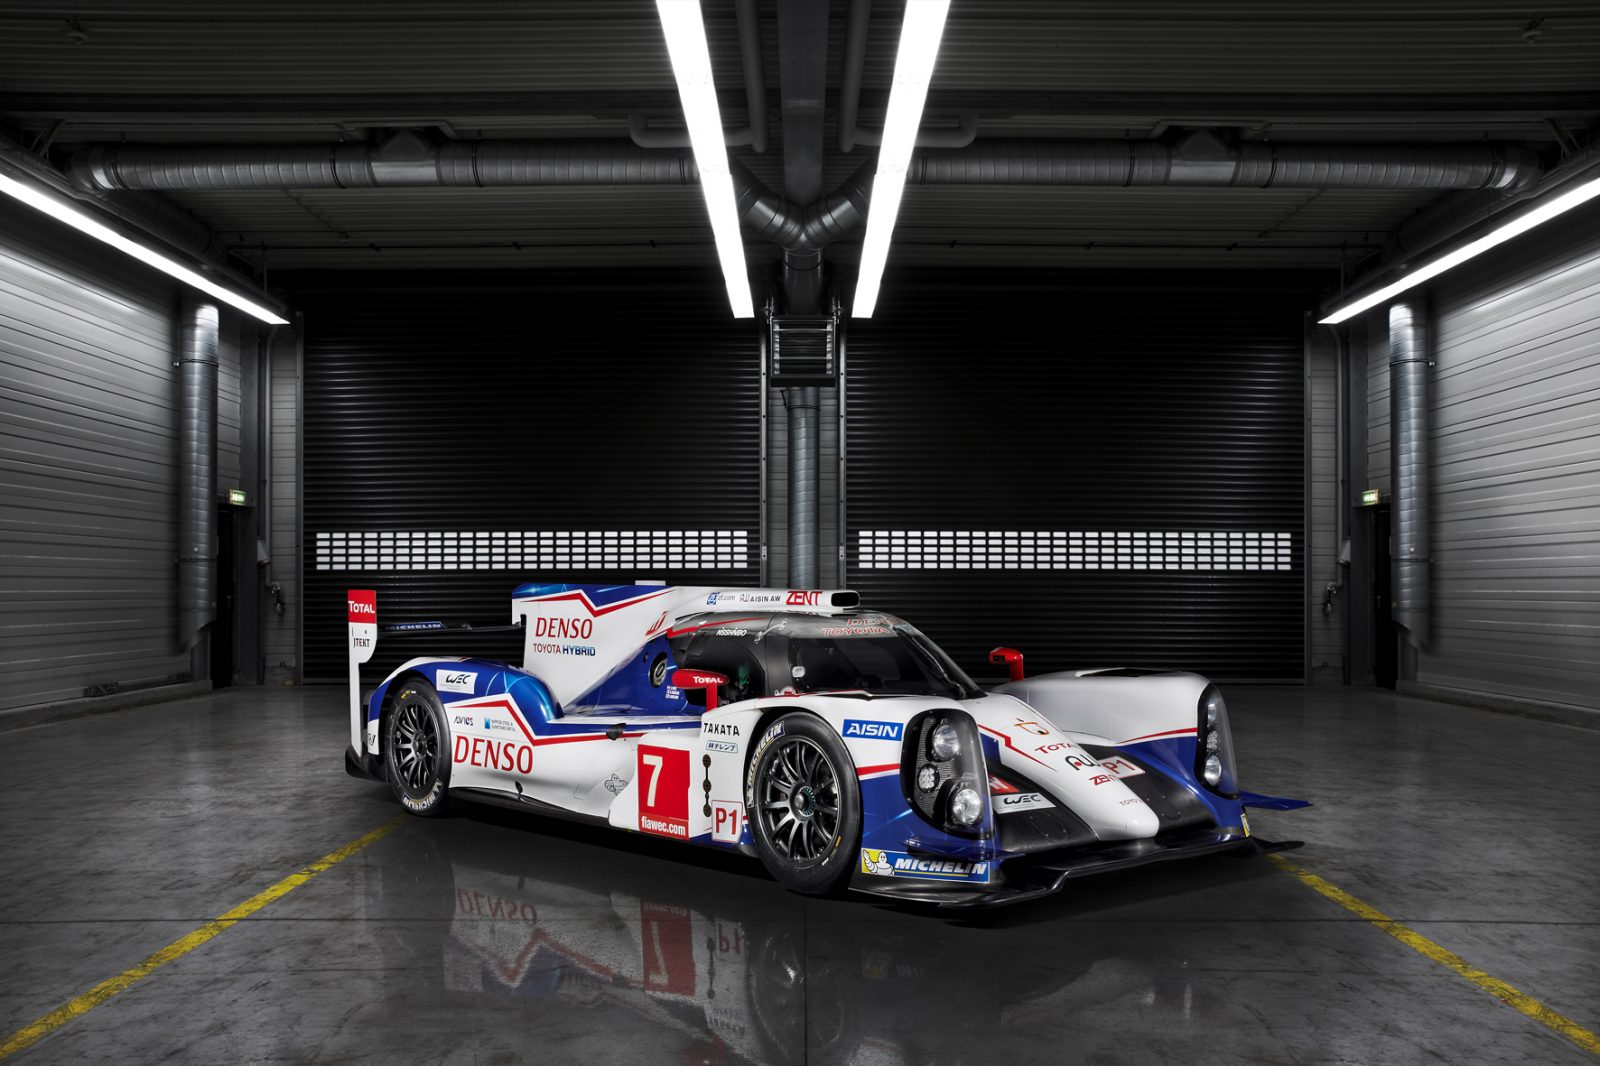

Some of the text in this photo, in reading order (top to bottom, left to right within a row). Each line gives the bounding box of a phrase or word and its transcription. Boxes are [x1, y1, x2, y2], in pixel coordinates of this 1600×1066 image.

[786, 591, 823, 606] ZENT
[348, 600, 376, 614] TOTAL
[535, 617, 593, 639] DENSO
[823, 626, 889, 637] TOYOTA
[353, 637, 370, 648] JTEKT
[533, 643, 596, 656] TOYOTA HYBRID
[445, 673, 472, 684] WEC
[693, 676, 724, 684] TOTAL
[704, 722, 740, 736] TAKATA
[847, 723, 899, 738] AISIN
[453, 735, 533, 774] DENSO
[1102, 759, 1136, 774] P1
[643, 754, 663, 807] 7
[1003, 794, 1042, 805] WEC
[641, 815, 686, 836] fiawec.com
[715, 807, 737, 836] P1
[894, 857, 988, 875] MICHELIN
